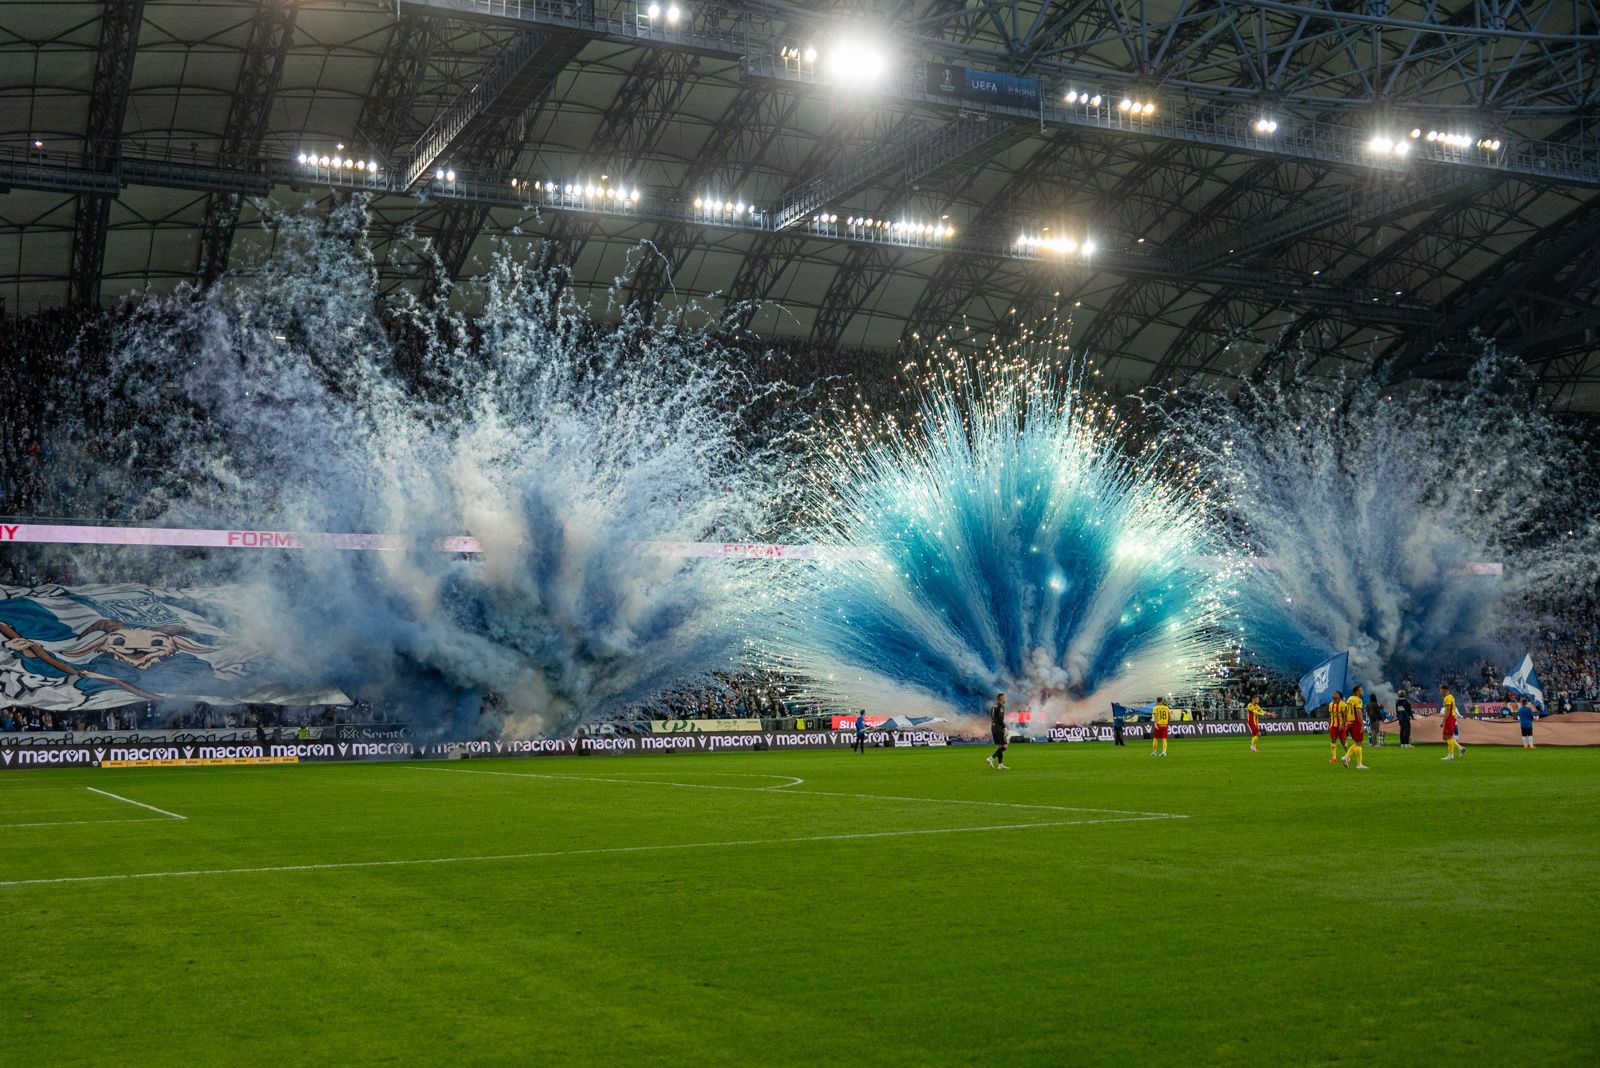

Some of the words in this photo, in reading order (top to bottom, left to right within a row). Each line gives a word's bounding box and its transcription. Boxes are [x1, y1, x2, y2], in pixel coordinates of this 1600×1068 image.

[971, 80, 998, 92] UEFA
[1159, 710, 1168, 720] 18
[18, 749, 90, 763] macron
[110, 747, 179, 761] macron
[199, 745, 264, 759] macron
[270, 744, 335, 757] macron
[352, 742, 414, 756] macron
[581, 738, 636, 750] macron
[641, 736, 696, 749] macron
[711, 734, 762, 747] macron
[776, 732, 827, 745] macron
[1048, 725, 1090, 738] macron
[1206, 722, 1246, 734] macron
[1297, 720, 1329, 731] macro
